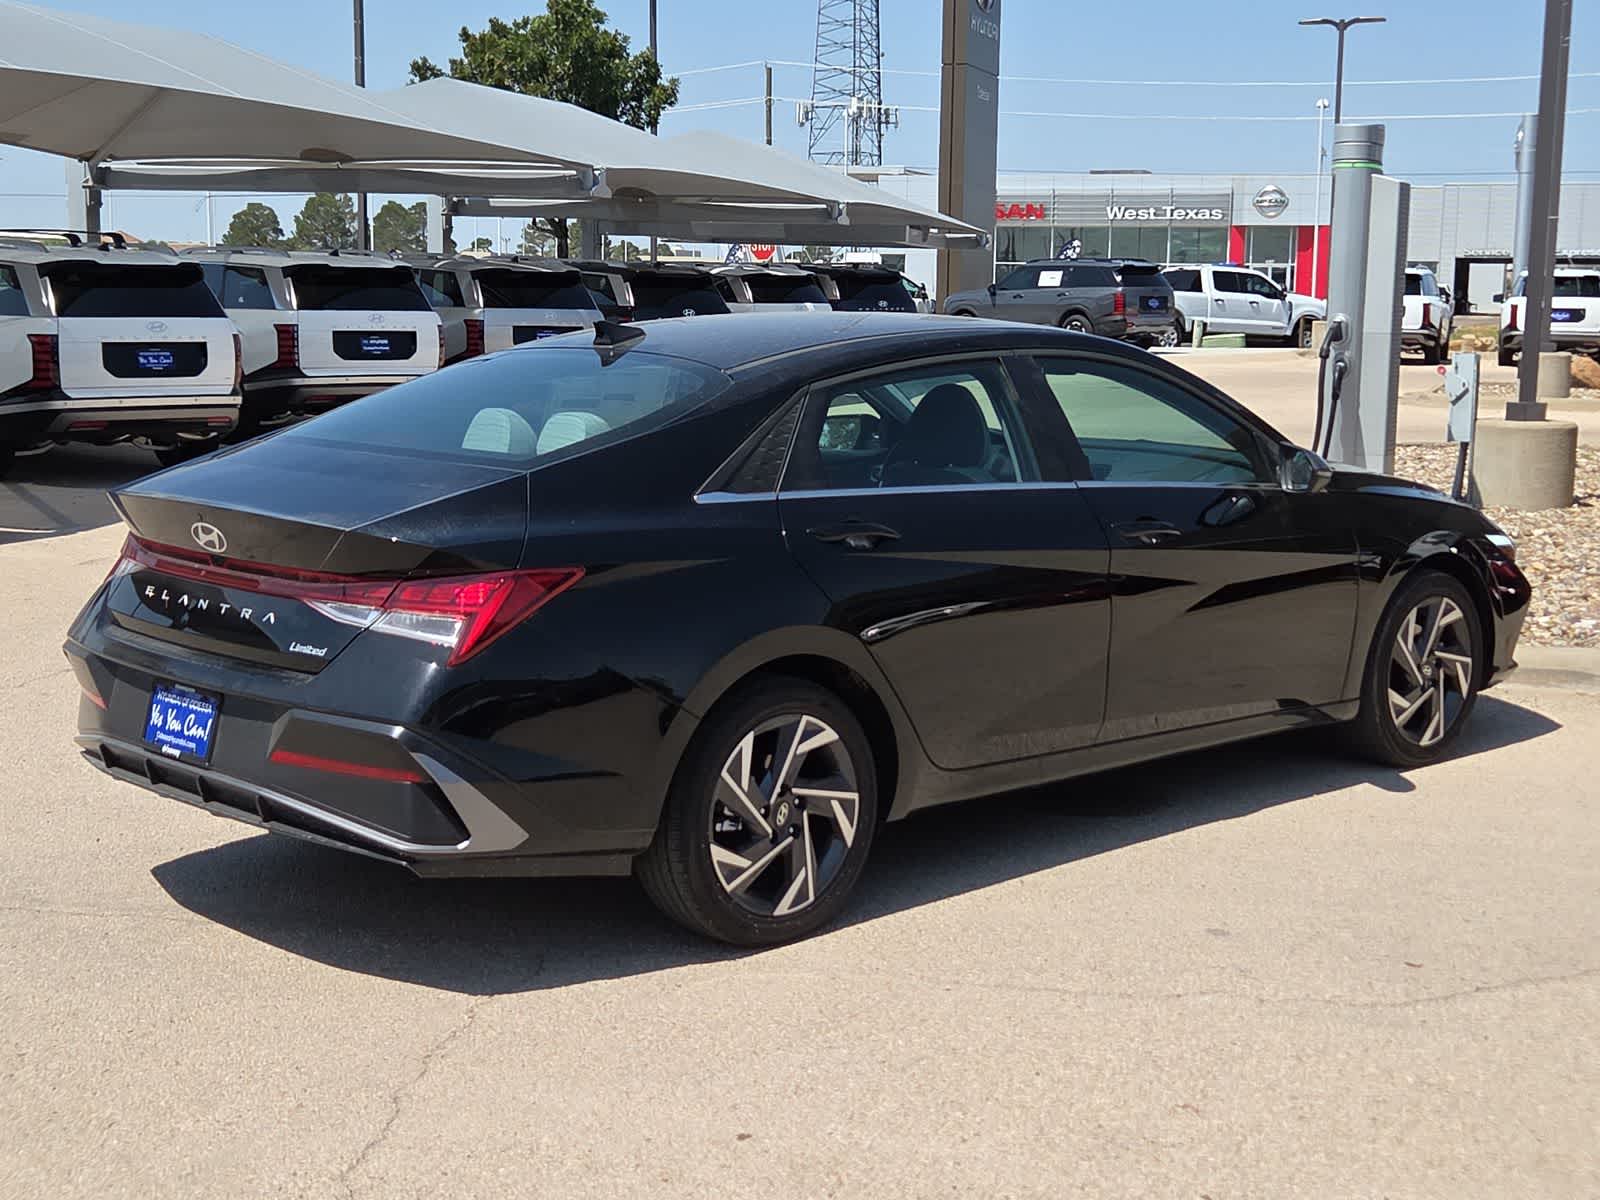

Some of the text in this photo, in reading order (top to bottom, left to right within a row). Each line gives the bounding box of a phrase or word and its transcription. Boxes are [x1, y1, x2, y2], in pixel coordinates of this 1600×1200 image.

[995, 202, 1044, 220] SAN
[1106, 206, 1223, 220] West Texas
[144, 585, 275, 625] ELANTRA
[288, 641, 328, 657] Limited
[150, 703, 213, 742] Yes You Can!
